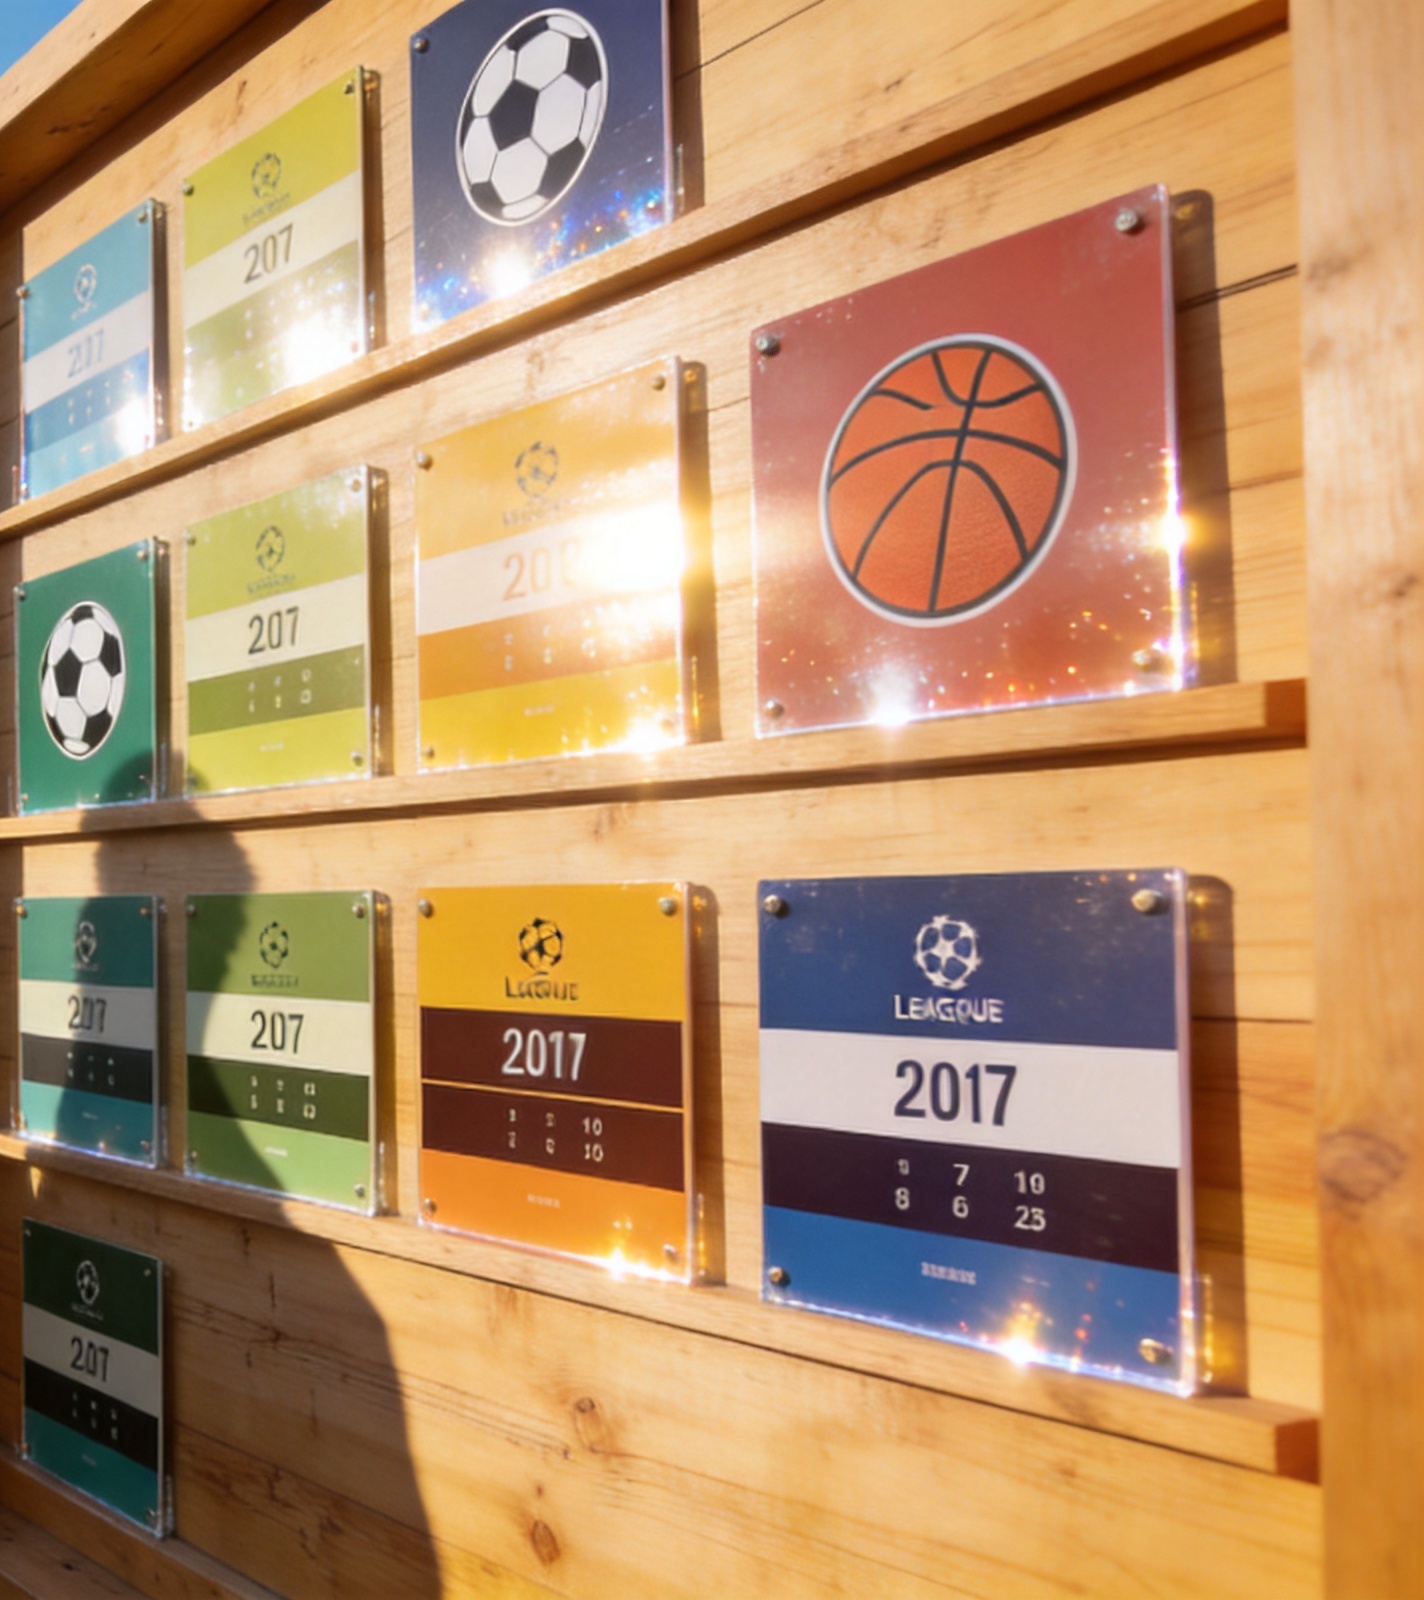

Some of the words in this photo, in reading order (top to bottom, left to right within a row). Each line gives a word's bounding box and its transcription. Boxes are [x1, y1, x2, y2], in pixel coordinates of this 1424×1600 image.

[243, 222, 294, 285] 207
[248, 605, 300, 655] 207
[250, 1009, 304, 1055] 207
[501, 1027, 587, 1081] 2017
[894, 1059, 1017, 1127] 2017
[952, 1163, 971, 1187] 7
[952, 1195, 969, 1219] 6
